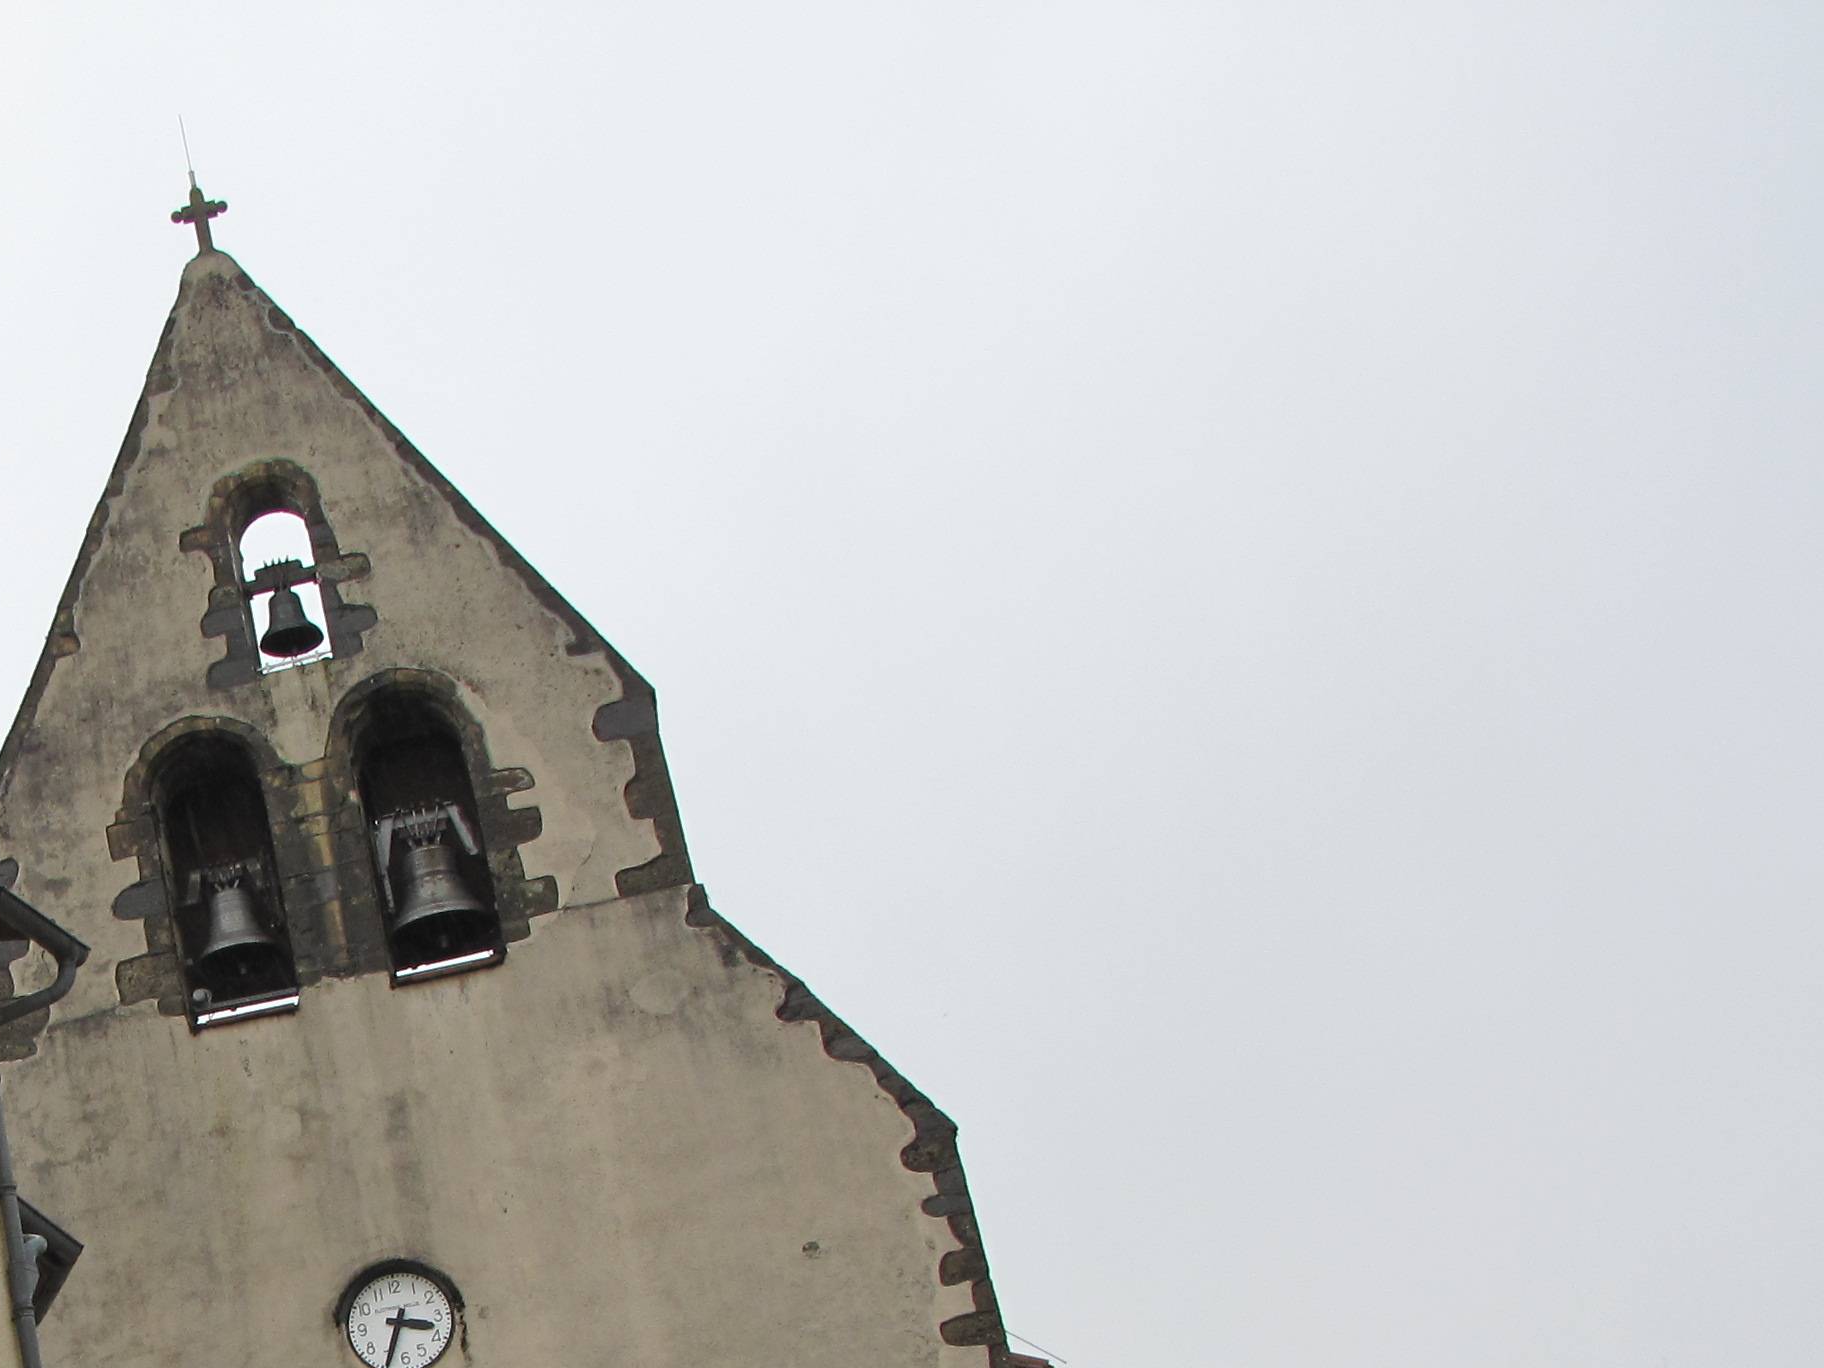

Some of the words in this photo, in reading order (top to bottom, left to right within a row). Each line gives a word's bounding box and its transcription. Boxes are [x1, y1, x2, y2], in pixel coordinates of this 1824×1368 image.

[387, 1279, 401, 1294] 12
[411, 1281, 416, 1295] 1
[373, 1287, 384, 1303] 11
[423, 1289, 435, 1304] 2
[357, 1302, 371, 1317] 10
[433, 1309, 443, 1322] 3
[357, 1323, 367, 1337] 9
[431, 1329, 442, 1342] 4
[366, 1341, 376, 1355] 8
[416, 1343, 427, 1357] 5
[400, 1351, 411, 1365] 6
